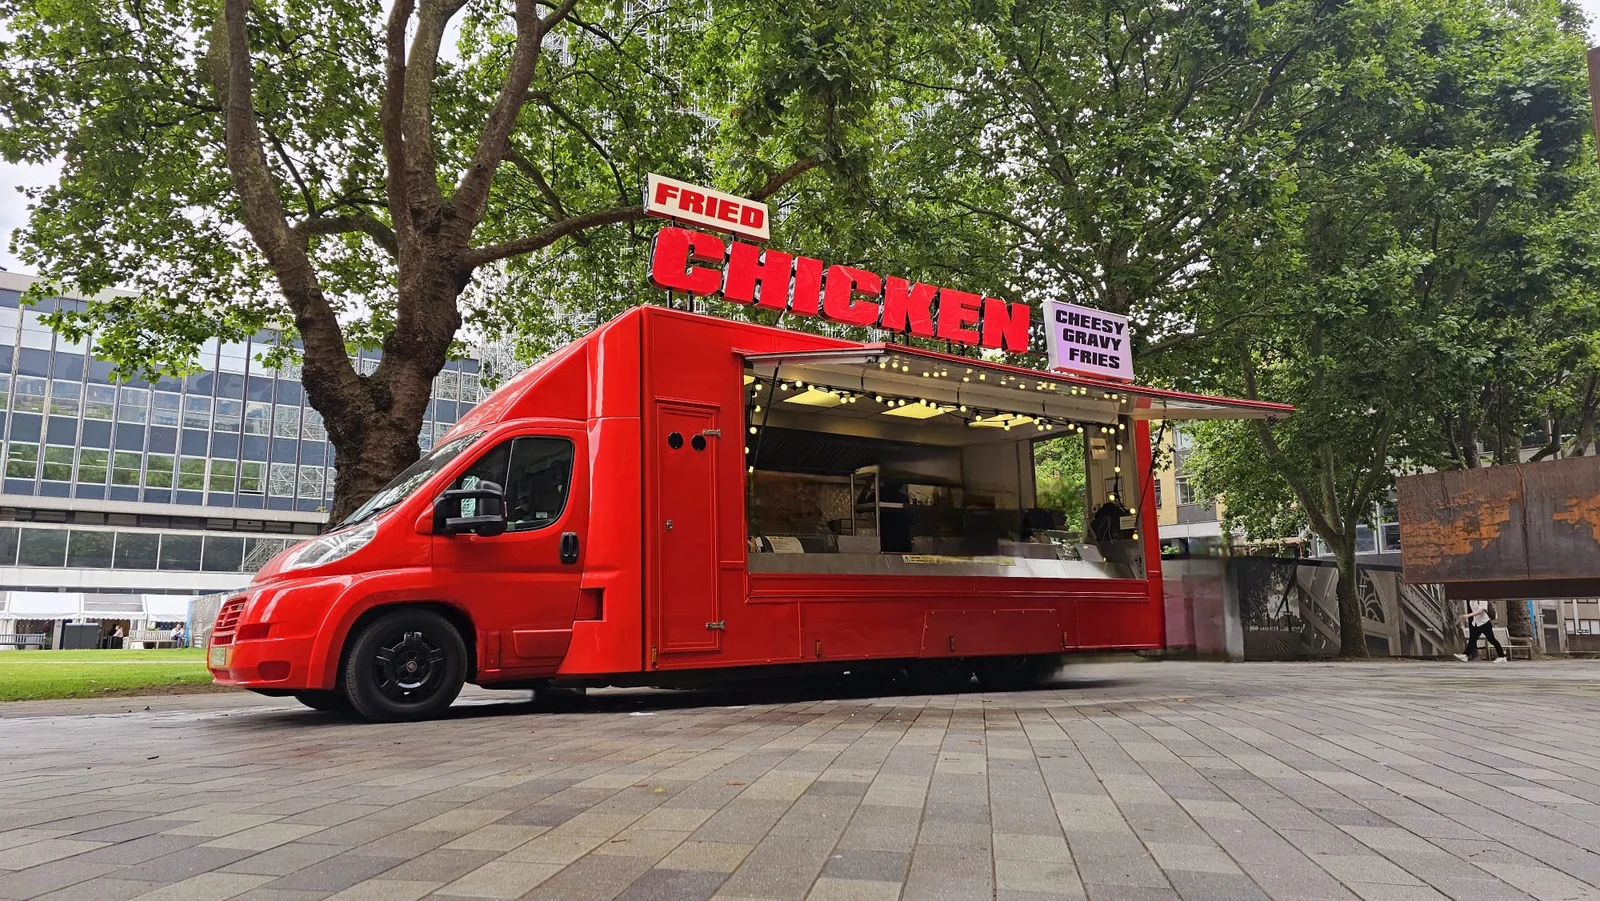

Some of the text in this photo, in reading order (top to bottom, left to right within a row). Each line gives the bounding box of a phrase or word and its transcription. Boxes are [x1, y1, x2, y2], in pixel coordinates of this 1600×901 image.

[655, 182, 764, 229] FRIED
[648, 226, 1031, 354] CHICKEN
[1055, 309, 1125, 335] CHEESY
[1062, 327, 1122, 351] GRAVY
[1069, 347, 1120, 369] FRIES
